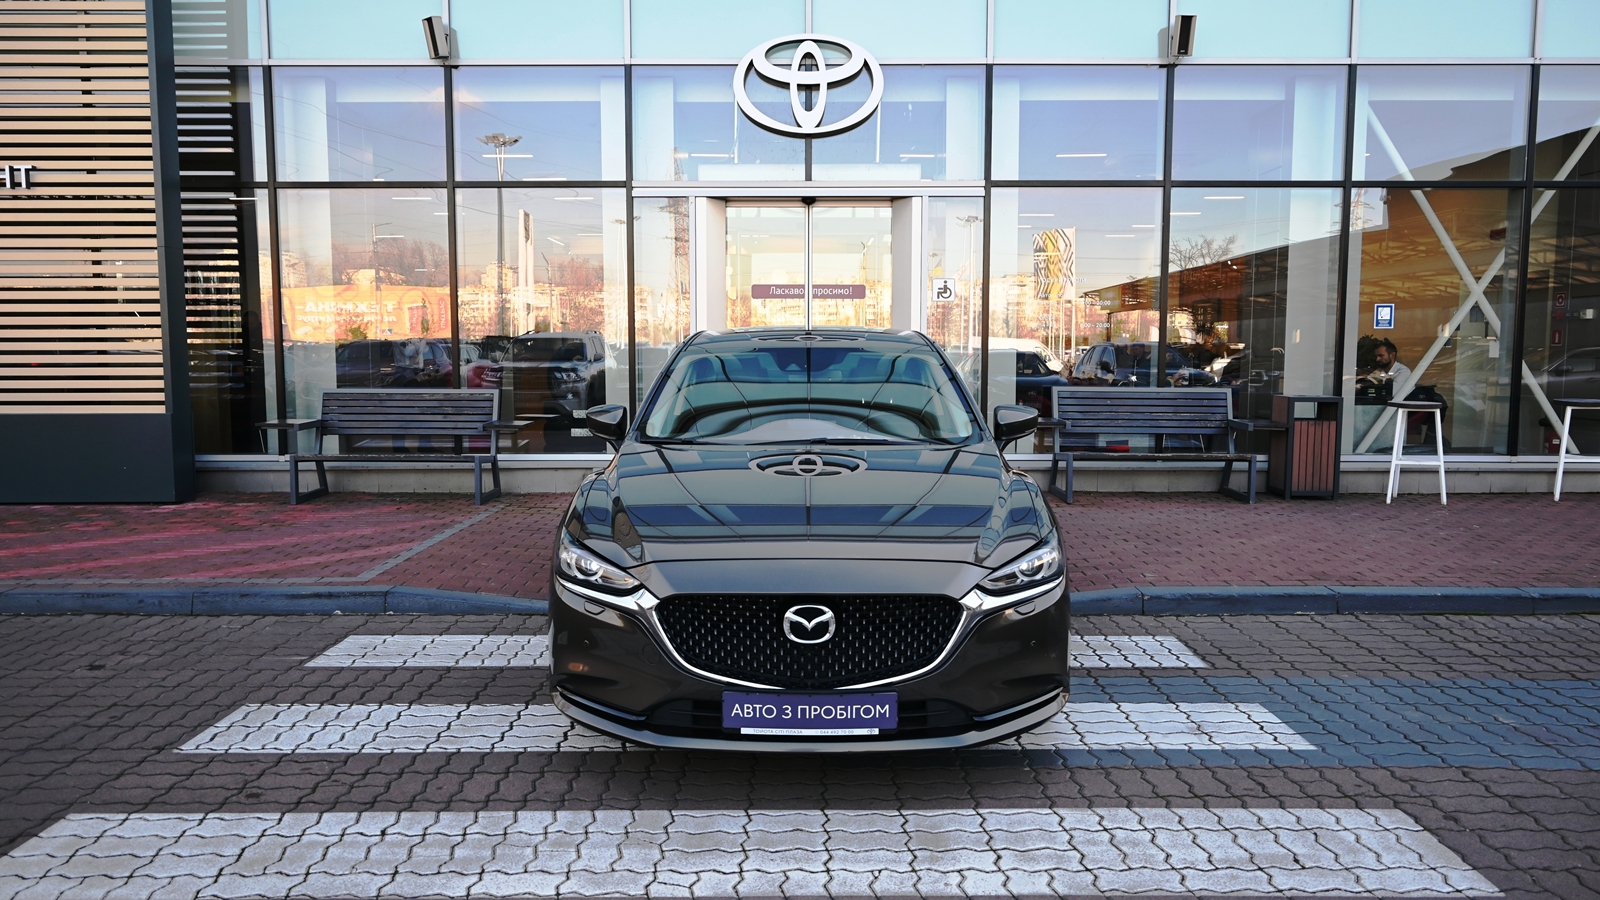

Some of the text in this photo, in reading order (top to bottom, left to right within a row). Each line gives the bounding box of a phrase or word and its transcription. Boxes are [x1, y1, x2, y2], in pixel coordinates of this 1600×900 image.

[769, 286, 853, 296] Ласкаво просимо!
[731, 703, 890, 719] АВТО З ПРОБІГОМ
